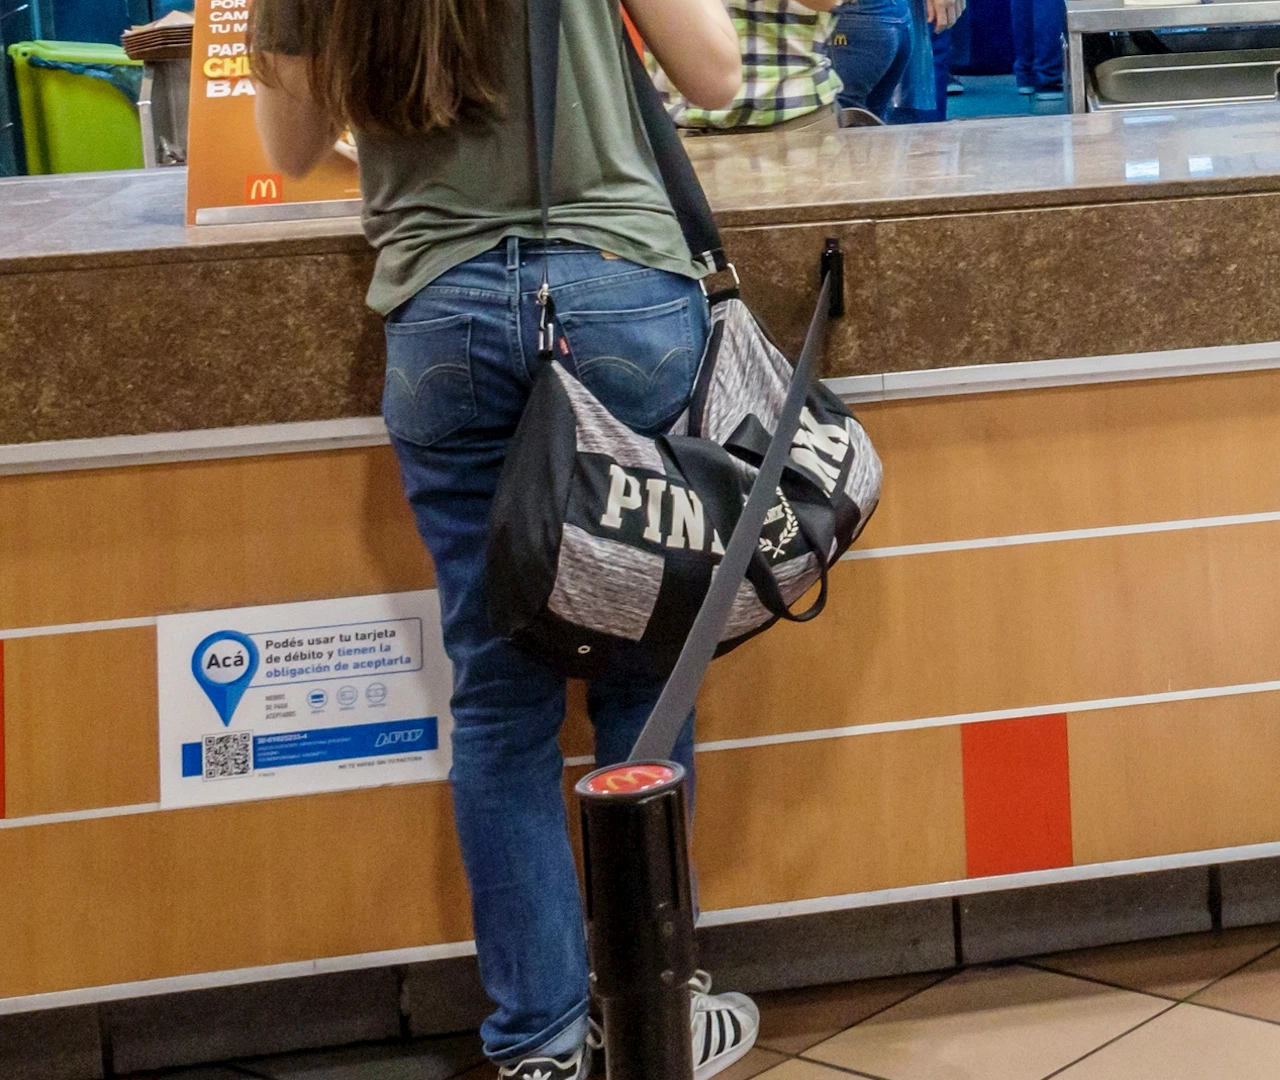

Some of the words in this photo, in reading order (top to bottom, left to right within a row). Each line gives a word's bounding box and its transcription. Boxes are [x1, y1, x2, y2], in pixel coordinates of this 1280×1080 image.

[210, 10, 249, 21] CAM
[208, 24, 231, 34] TU
[265, 636, 304, 650] Podés
[307, 634, 335, 646] usar
[339, 632, 352, 642] tu
[355, 628, 396, 643] tarjeta
[206, 650, 244, 670] Acá
[265, 652, 281, 664] de
[285, 648, 324, 663] débito
[327, 651, 334, 661] y
[337, 645, 376, 657] tienen
[380, 643, 391, 653] la
[265, 663, 330, 679] obligación
[334, 661, 349, 672] de
[352, 655, 412, 671] aceptarla
